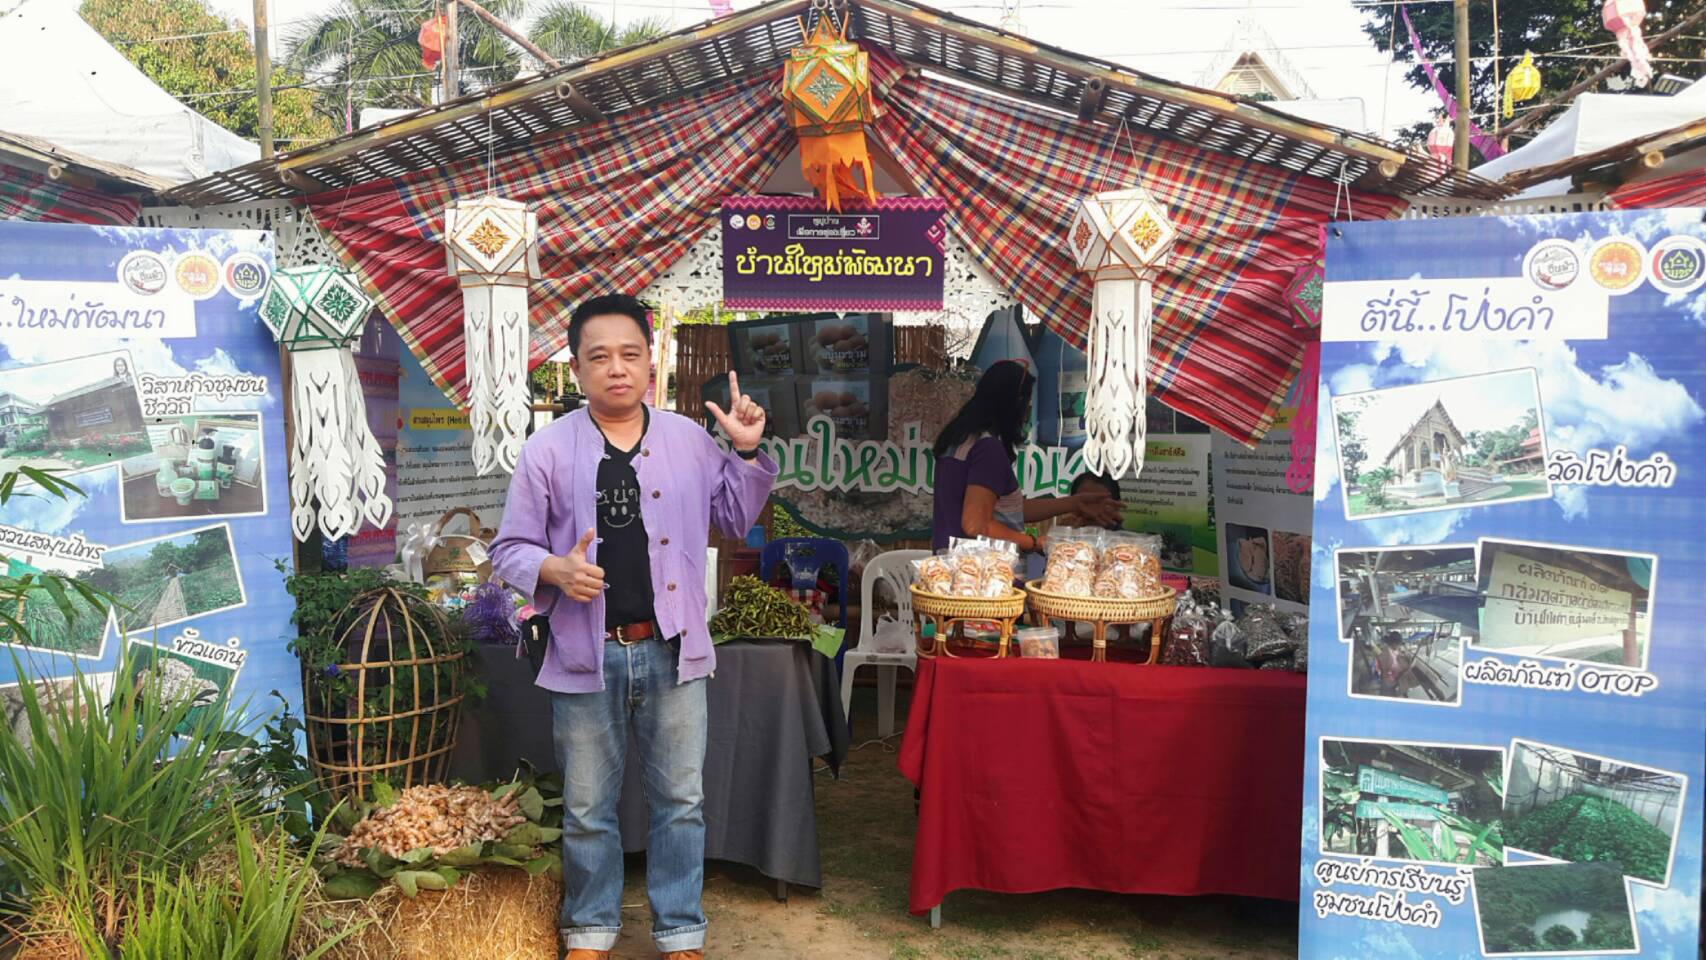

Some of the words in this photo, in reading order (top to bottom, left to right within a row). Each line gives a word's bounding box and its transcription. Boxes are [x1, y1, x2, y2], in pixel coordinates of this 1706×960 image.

[736, 243, 933, 282] บ้านใหม่พัฒนา
[142, 374, 265, 400] วิสาหกิจชุมชน
[1548, 447, 1673, 484] วัดโป่งคำ
[1465, 661, 1576, 688] ผลิตภัณฑ์
[1581, 671, 1655, 693] OTOP
[1316, 858, 1471, 901] ศูนย์การเรียนรู้
[1316, 891, 1441, 927] ชุมชนโป่งคำ
